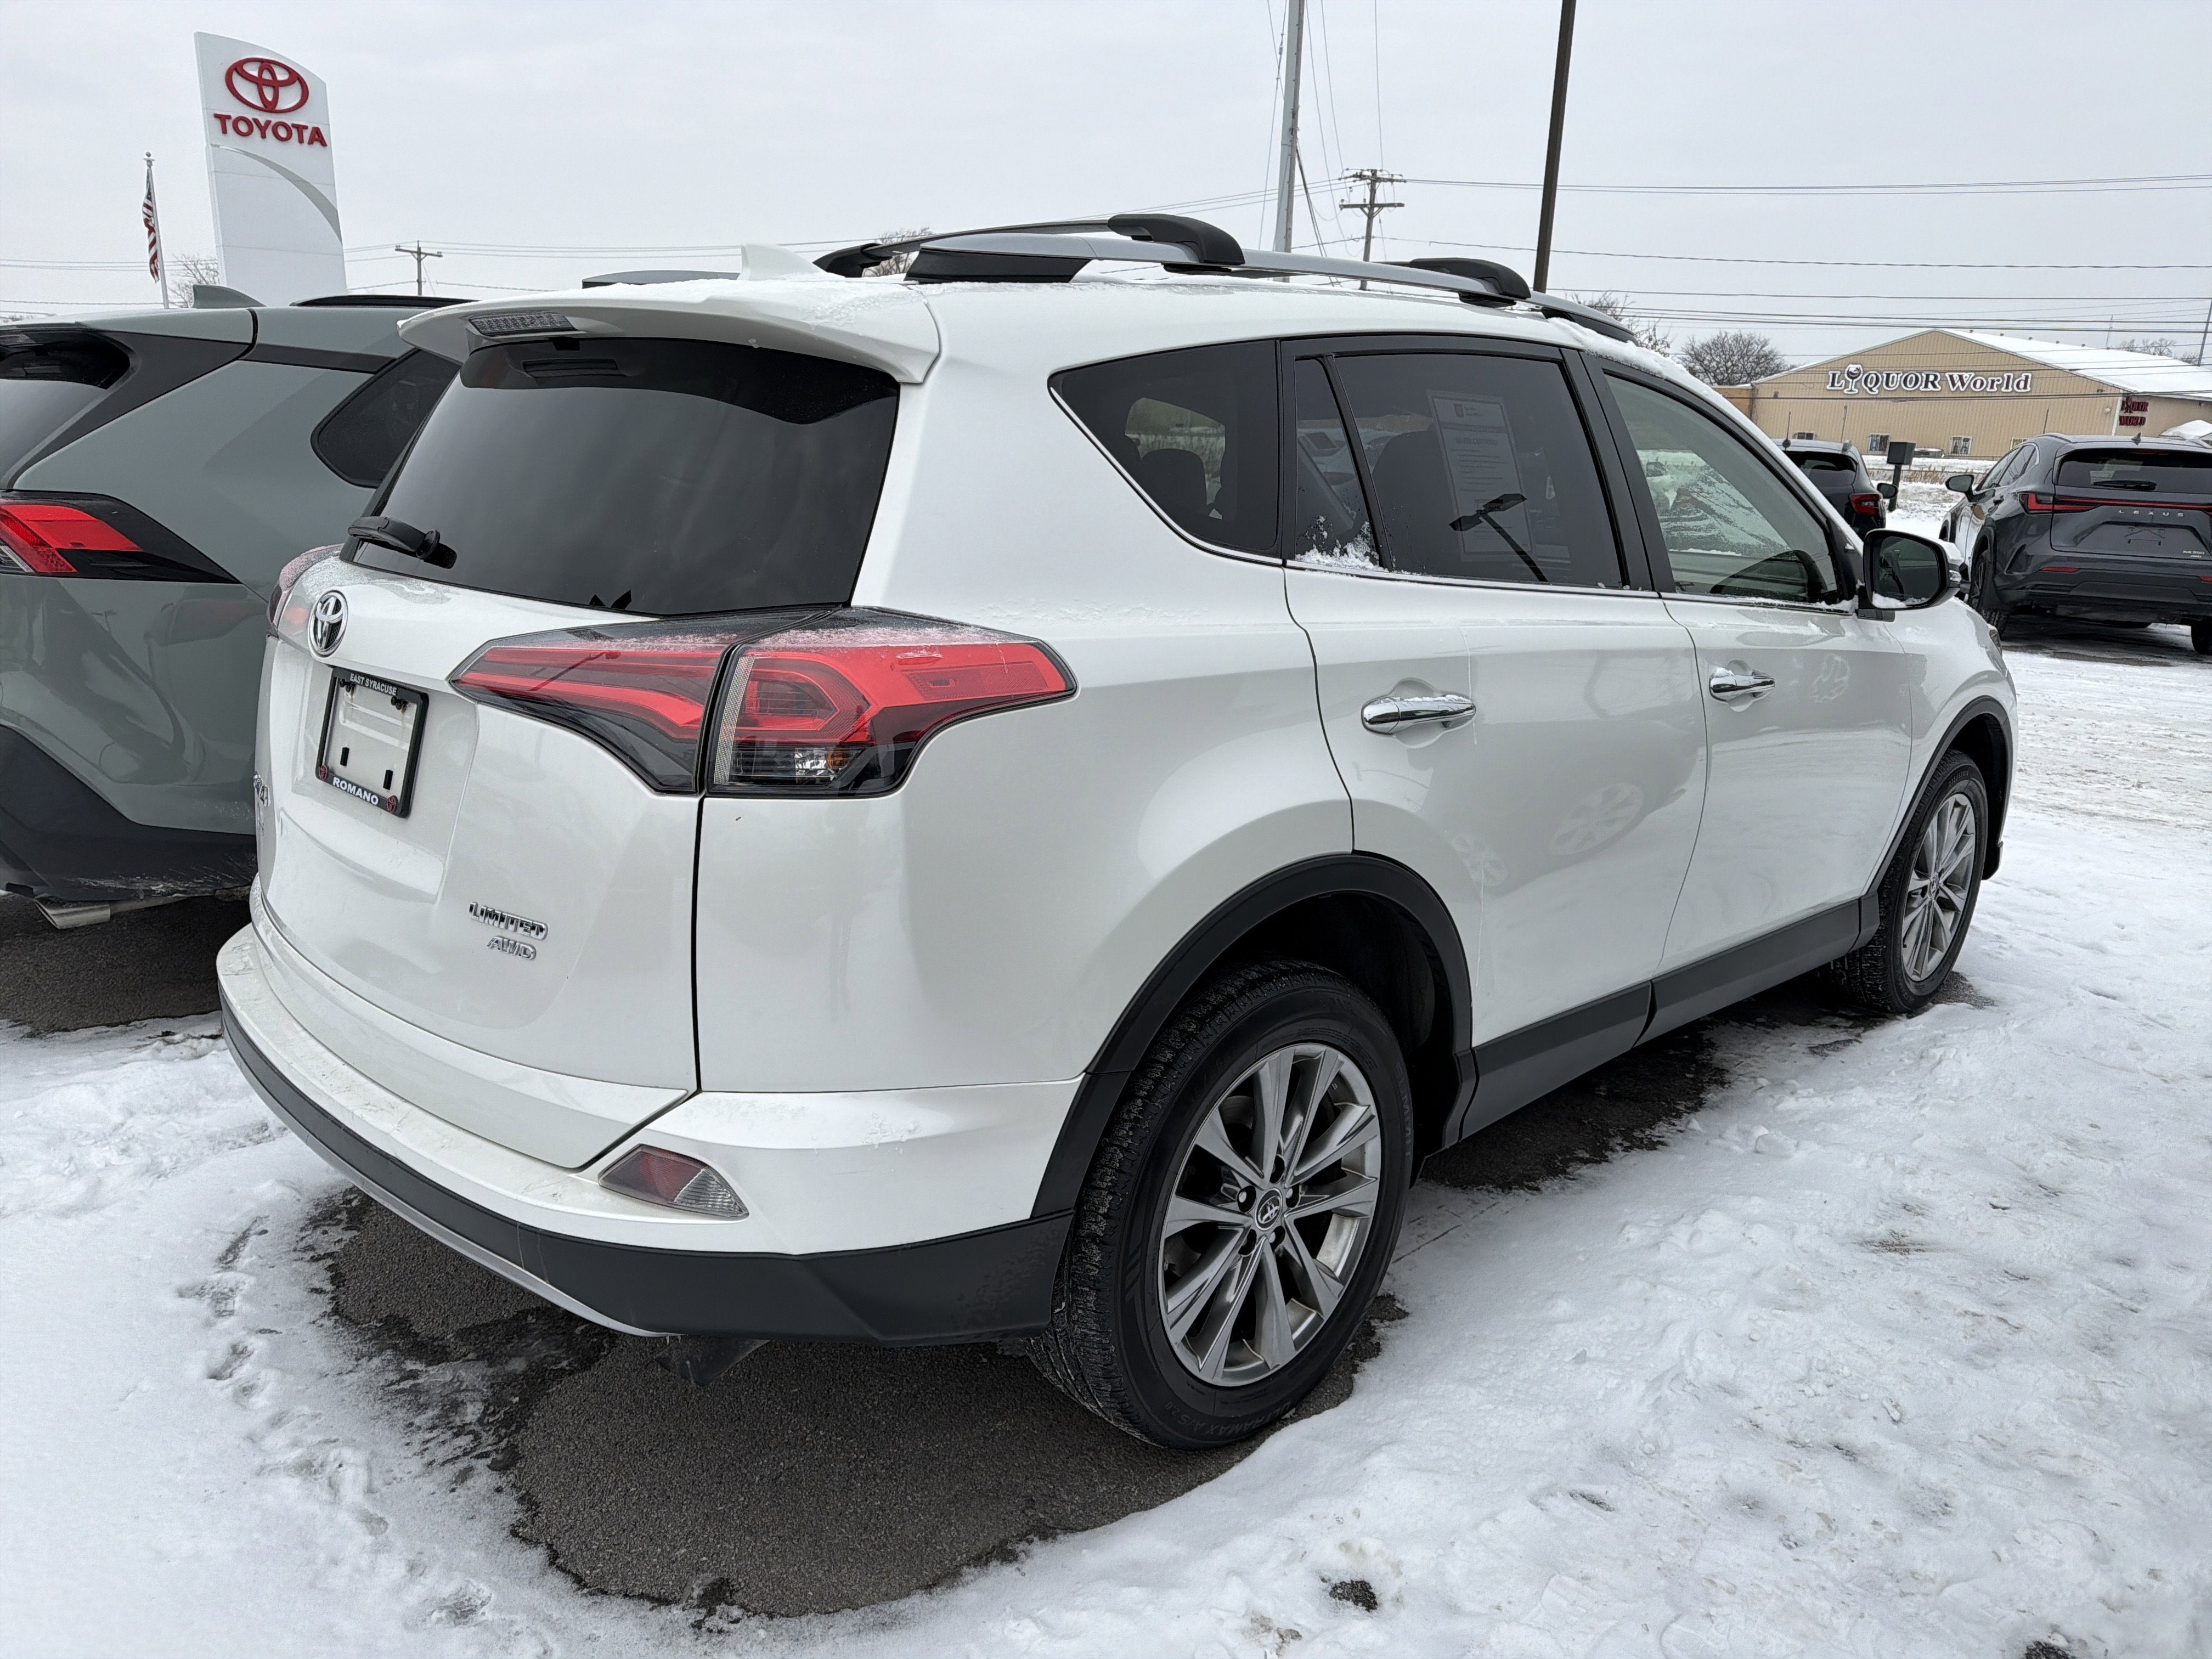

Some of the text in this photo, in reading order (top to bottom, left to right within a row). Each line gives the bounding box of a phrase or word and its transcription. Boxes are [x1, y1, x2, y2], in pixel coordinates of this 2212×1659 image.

[213, 113, 328, 147] TOYOTA
[1945, 372, 2032, 392] World
[2119, 509, 2184, 517] LEXUS
[349, 673, 397, 696] EAST SYRACUSE
[332, 776, 379, 806] ROMANO
[469, 901, 548, 941] LIMITED
[486, 935, 537, 961] AWD
